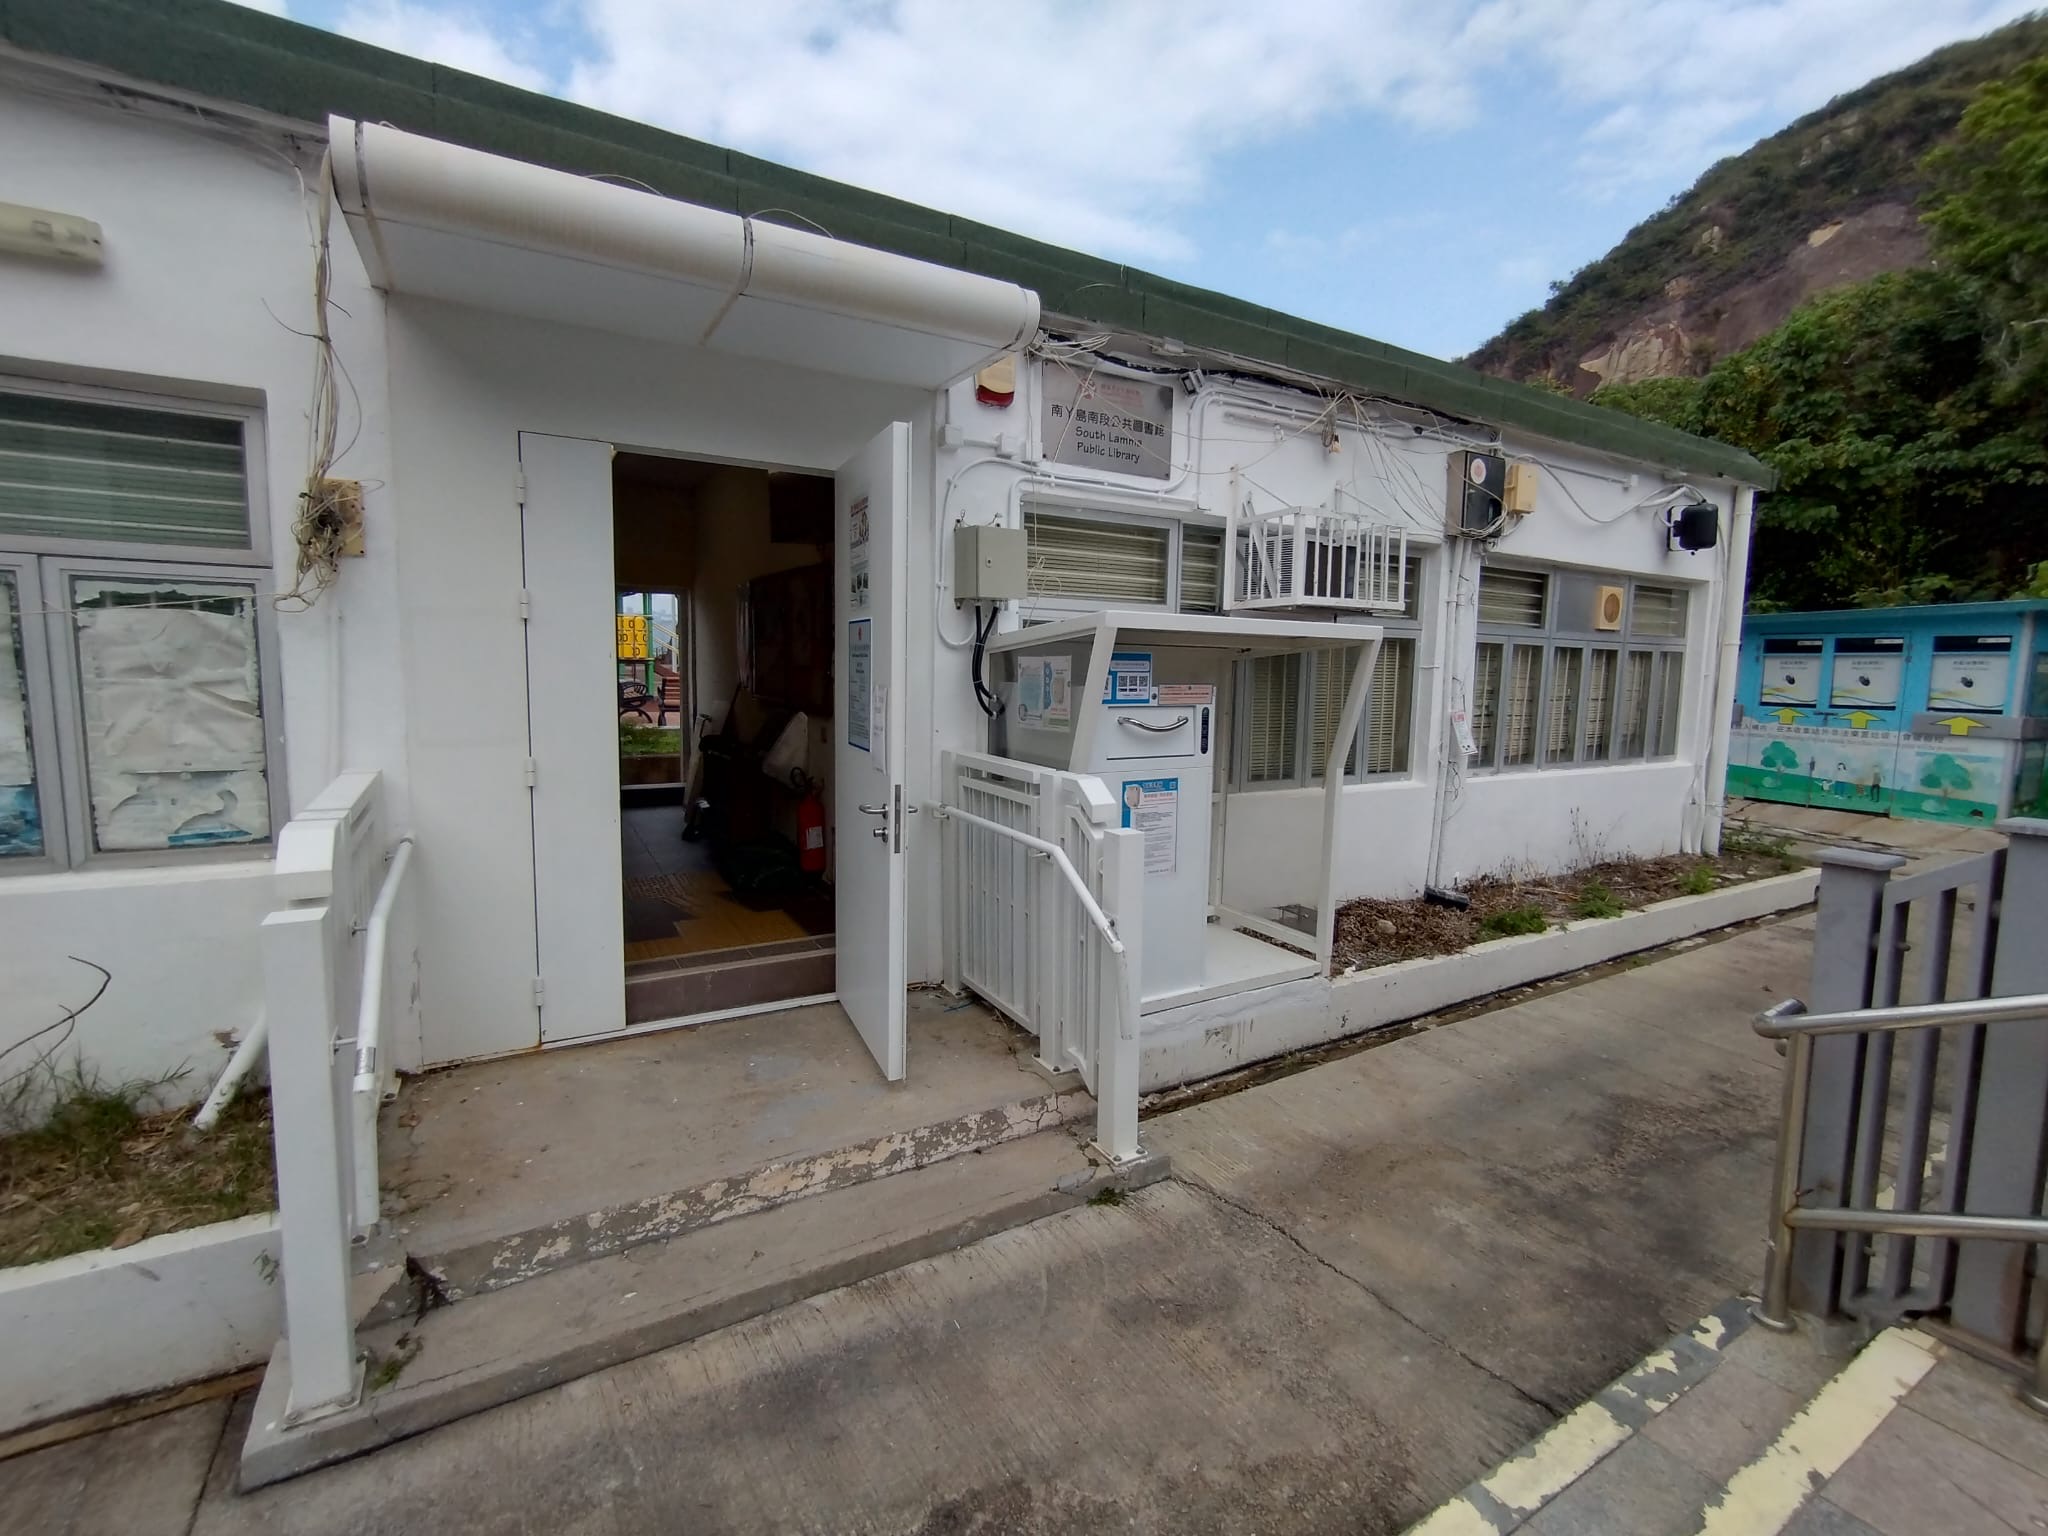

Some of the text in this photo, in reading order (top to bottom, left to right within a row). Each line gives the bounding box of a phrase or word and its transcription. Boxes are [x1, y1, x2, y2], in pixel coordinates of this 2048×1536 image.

[1075, 426, 1143, 448] South Lamma
[1077, 442, 1140, 464] Public Library
